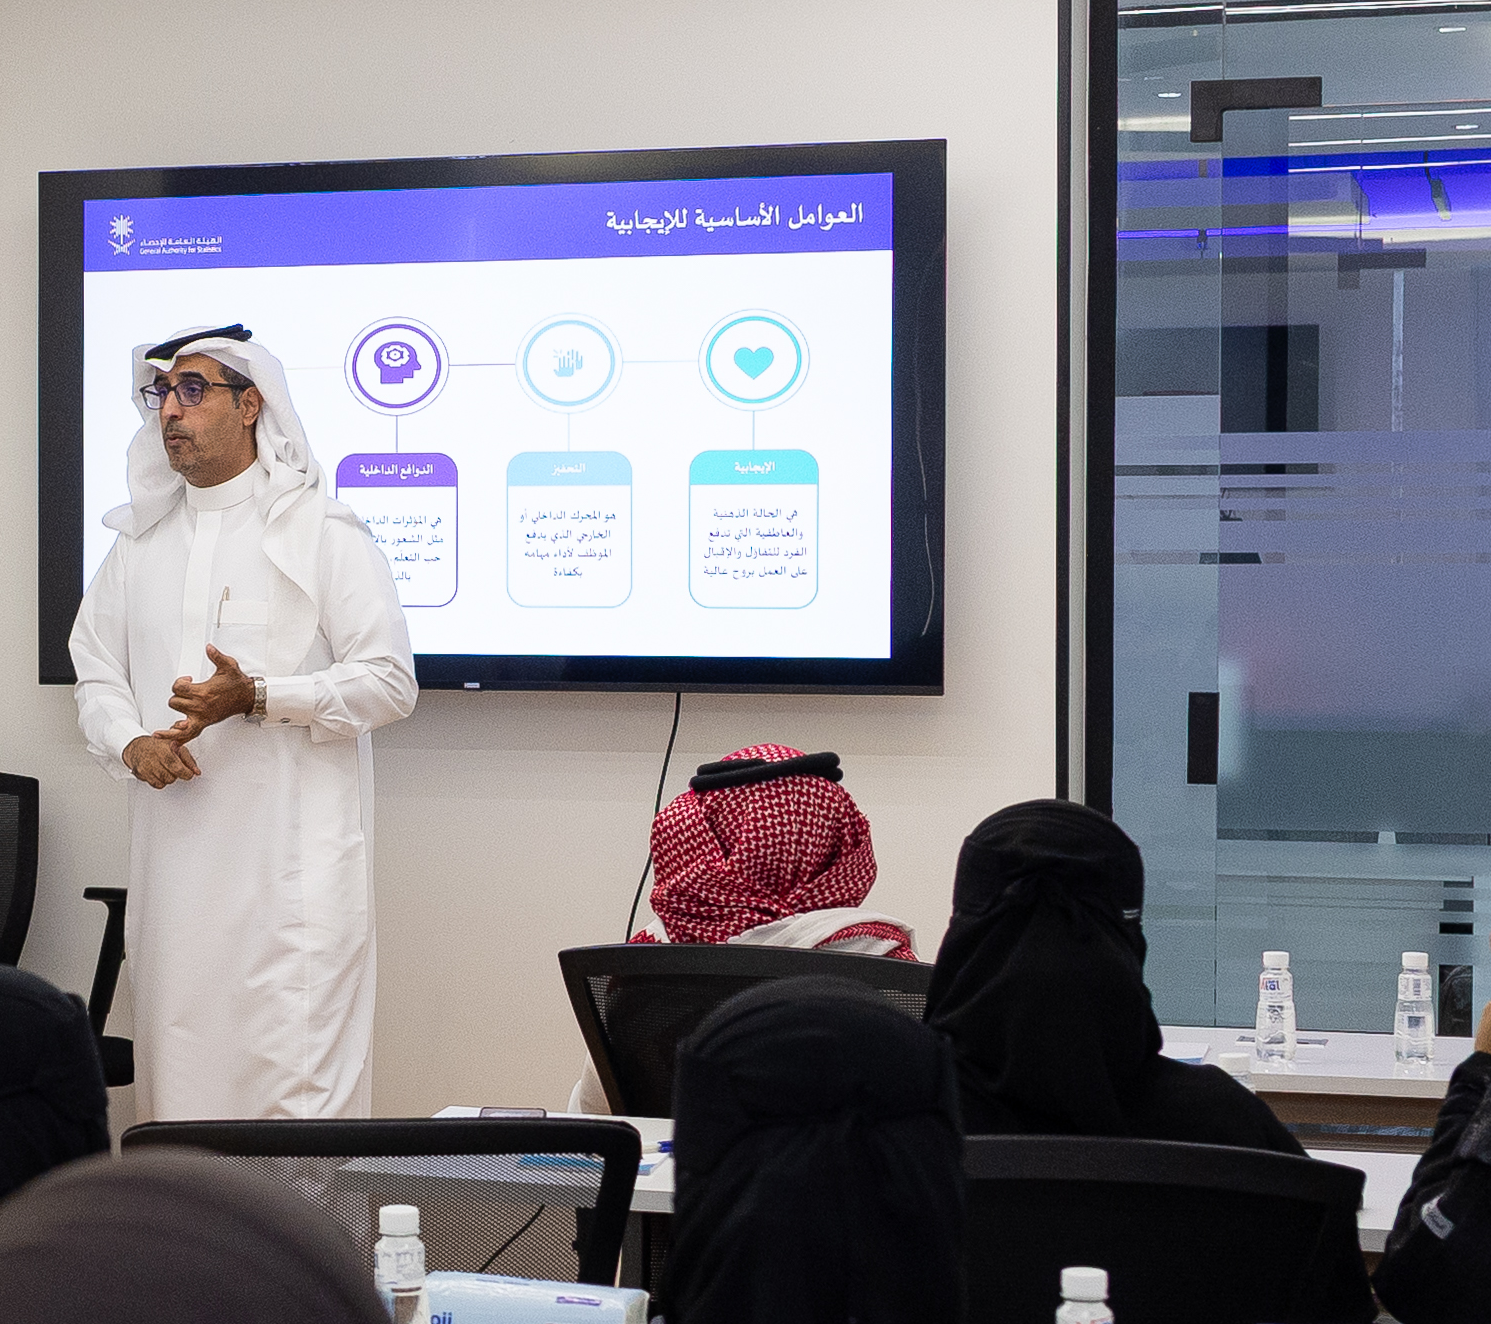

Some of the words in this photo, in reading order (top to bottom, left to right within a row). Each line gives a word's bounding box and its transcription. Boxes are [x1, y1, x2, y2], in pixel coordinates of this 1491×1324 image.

[606, 207, 688, 235] للإيجابية
[695, 202, 780, 232] الأساسية
[788, 202, 863, 231] العوامل
[168, 237, 195, 245] العامة
[140, 247, 161, 255] General
[161, 247, 187, 255] Authority
[359, 464, 398, 478] الداخلية
[400, 463, 434, 480] الدوافع
[734, 461, 776, 475] الإيجابية
[532, 510, 566, 524] الداخلي
[604, 513, 616, 523] هو
[753, 508, 781, 518] الحالة
[786, 509, 798, 523] هي
[431, 516, 442, 529] هي
[427, 534, 444, 546] مثل
[525, 530, 547, 544] يدفع
[551, 530, 572, 544] الذي
[708, 528, 731, 542] تدفع
[734, 527, 751, 542] التي
[759, 566, 786, 578] العمل
